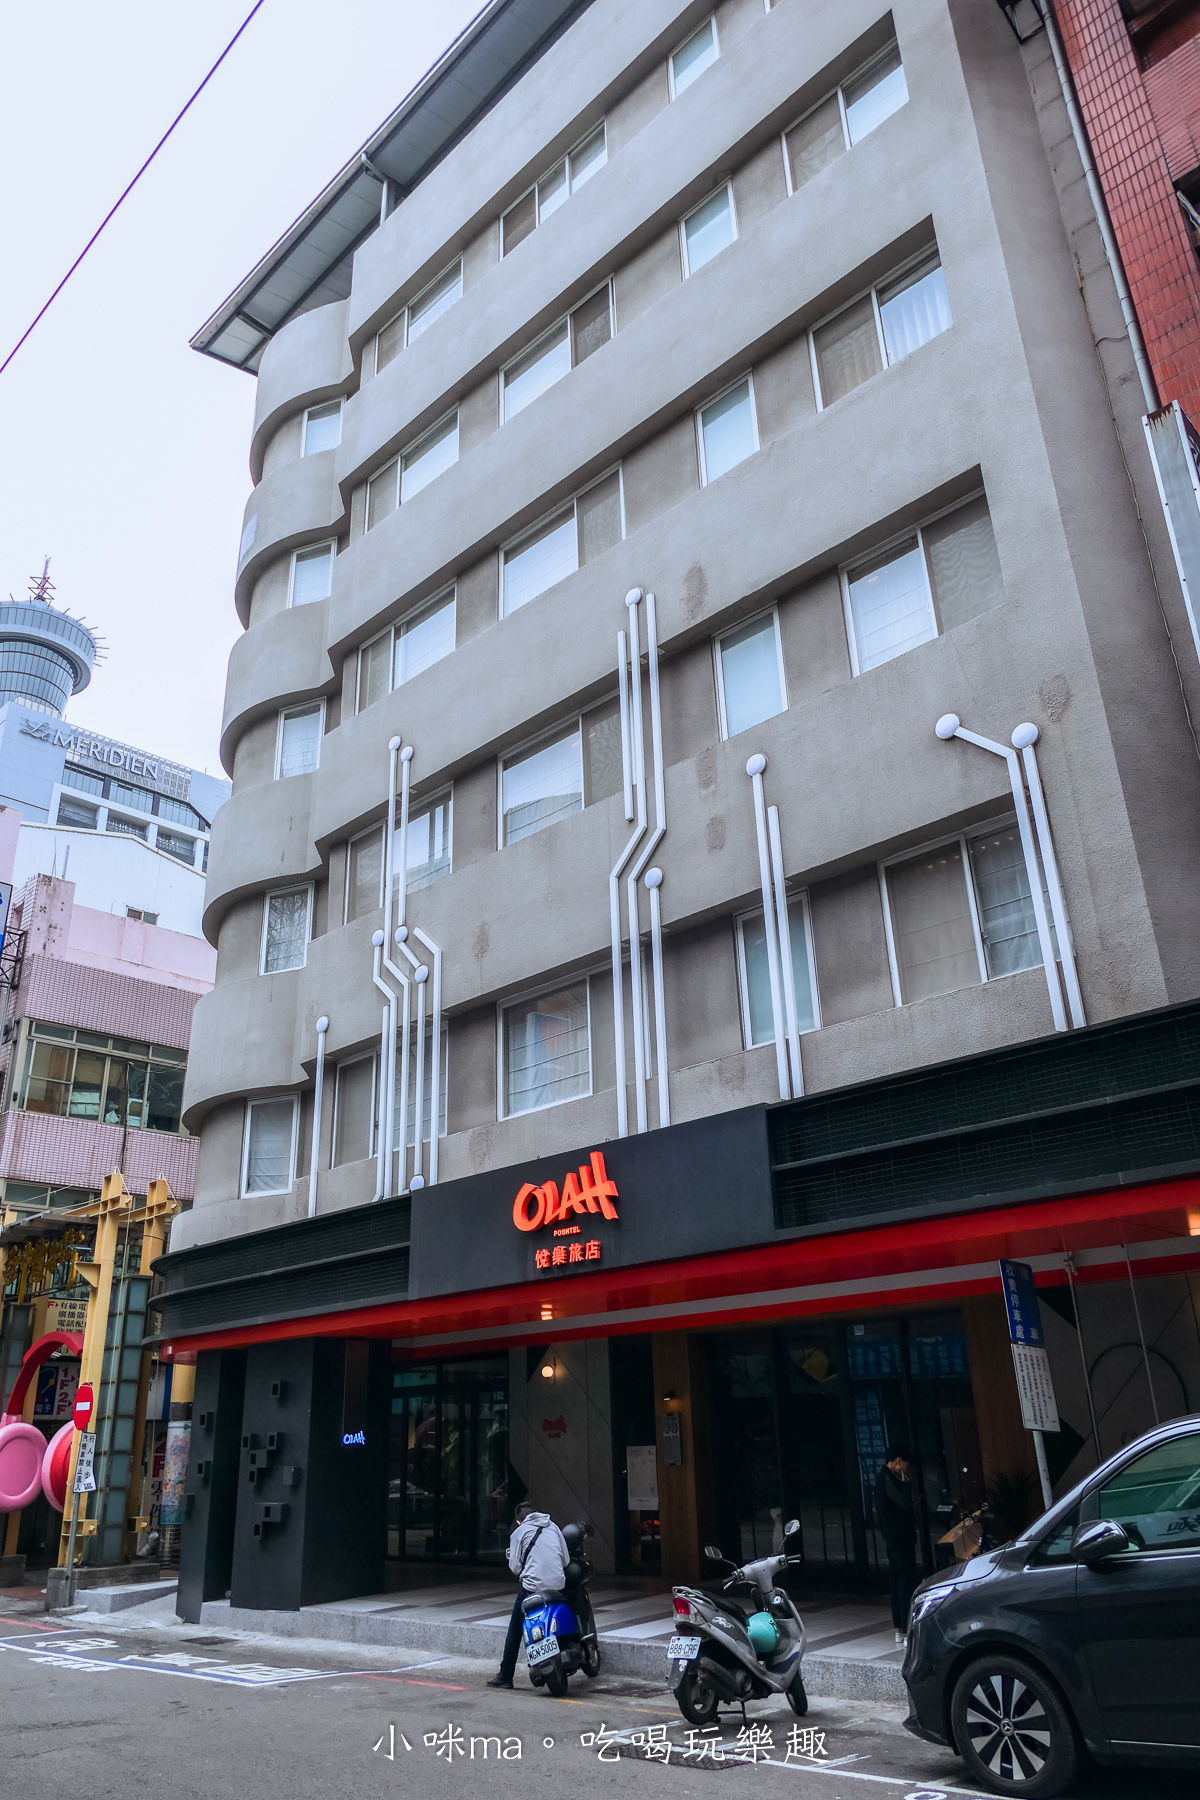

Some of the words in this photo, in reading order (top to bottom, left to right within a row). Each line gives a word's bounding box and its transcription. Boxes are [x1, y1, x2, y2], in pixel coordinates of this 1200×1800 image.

[19, 719, 51, 740] Le
[53, 729, 159, 781] MERIDIEN
[512, 1151, 619, 1231] OLAH
[553, 1226, 582, 1237] POSHTEL
[535, 1239, 601, 1269] 悅樂旅店
[58, 1310, 87, 1319] 廣播器
[60, 1302, 88, 1311] 有線電
[1005, 1264, 1025, 1339] 收費停車處
[342, 1430, 366, 1446] OLAH
[83, 1435, 95, 1490] 行人徒步區
